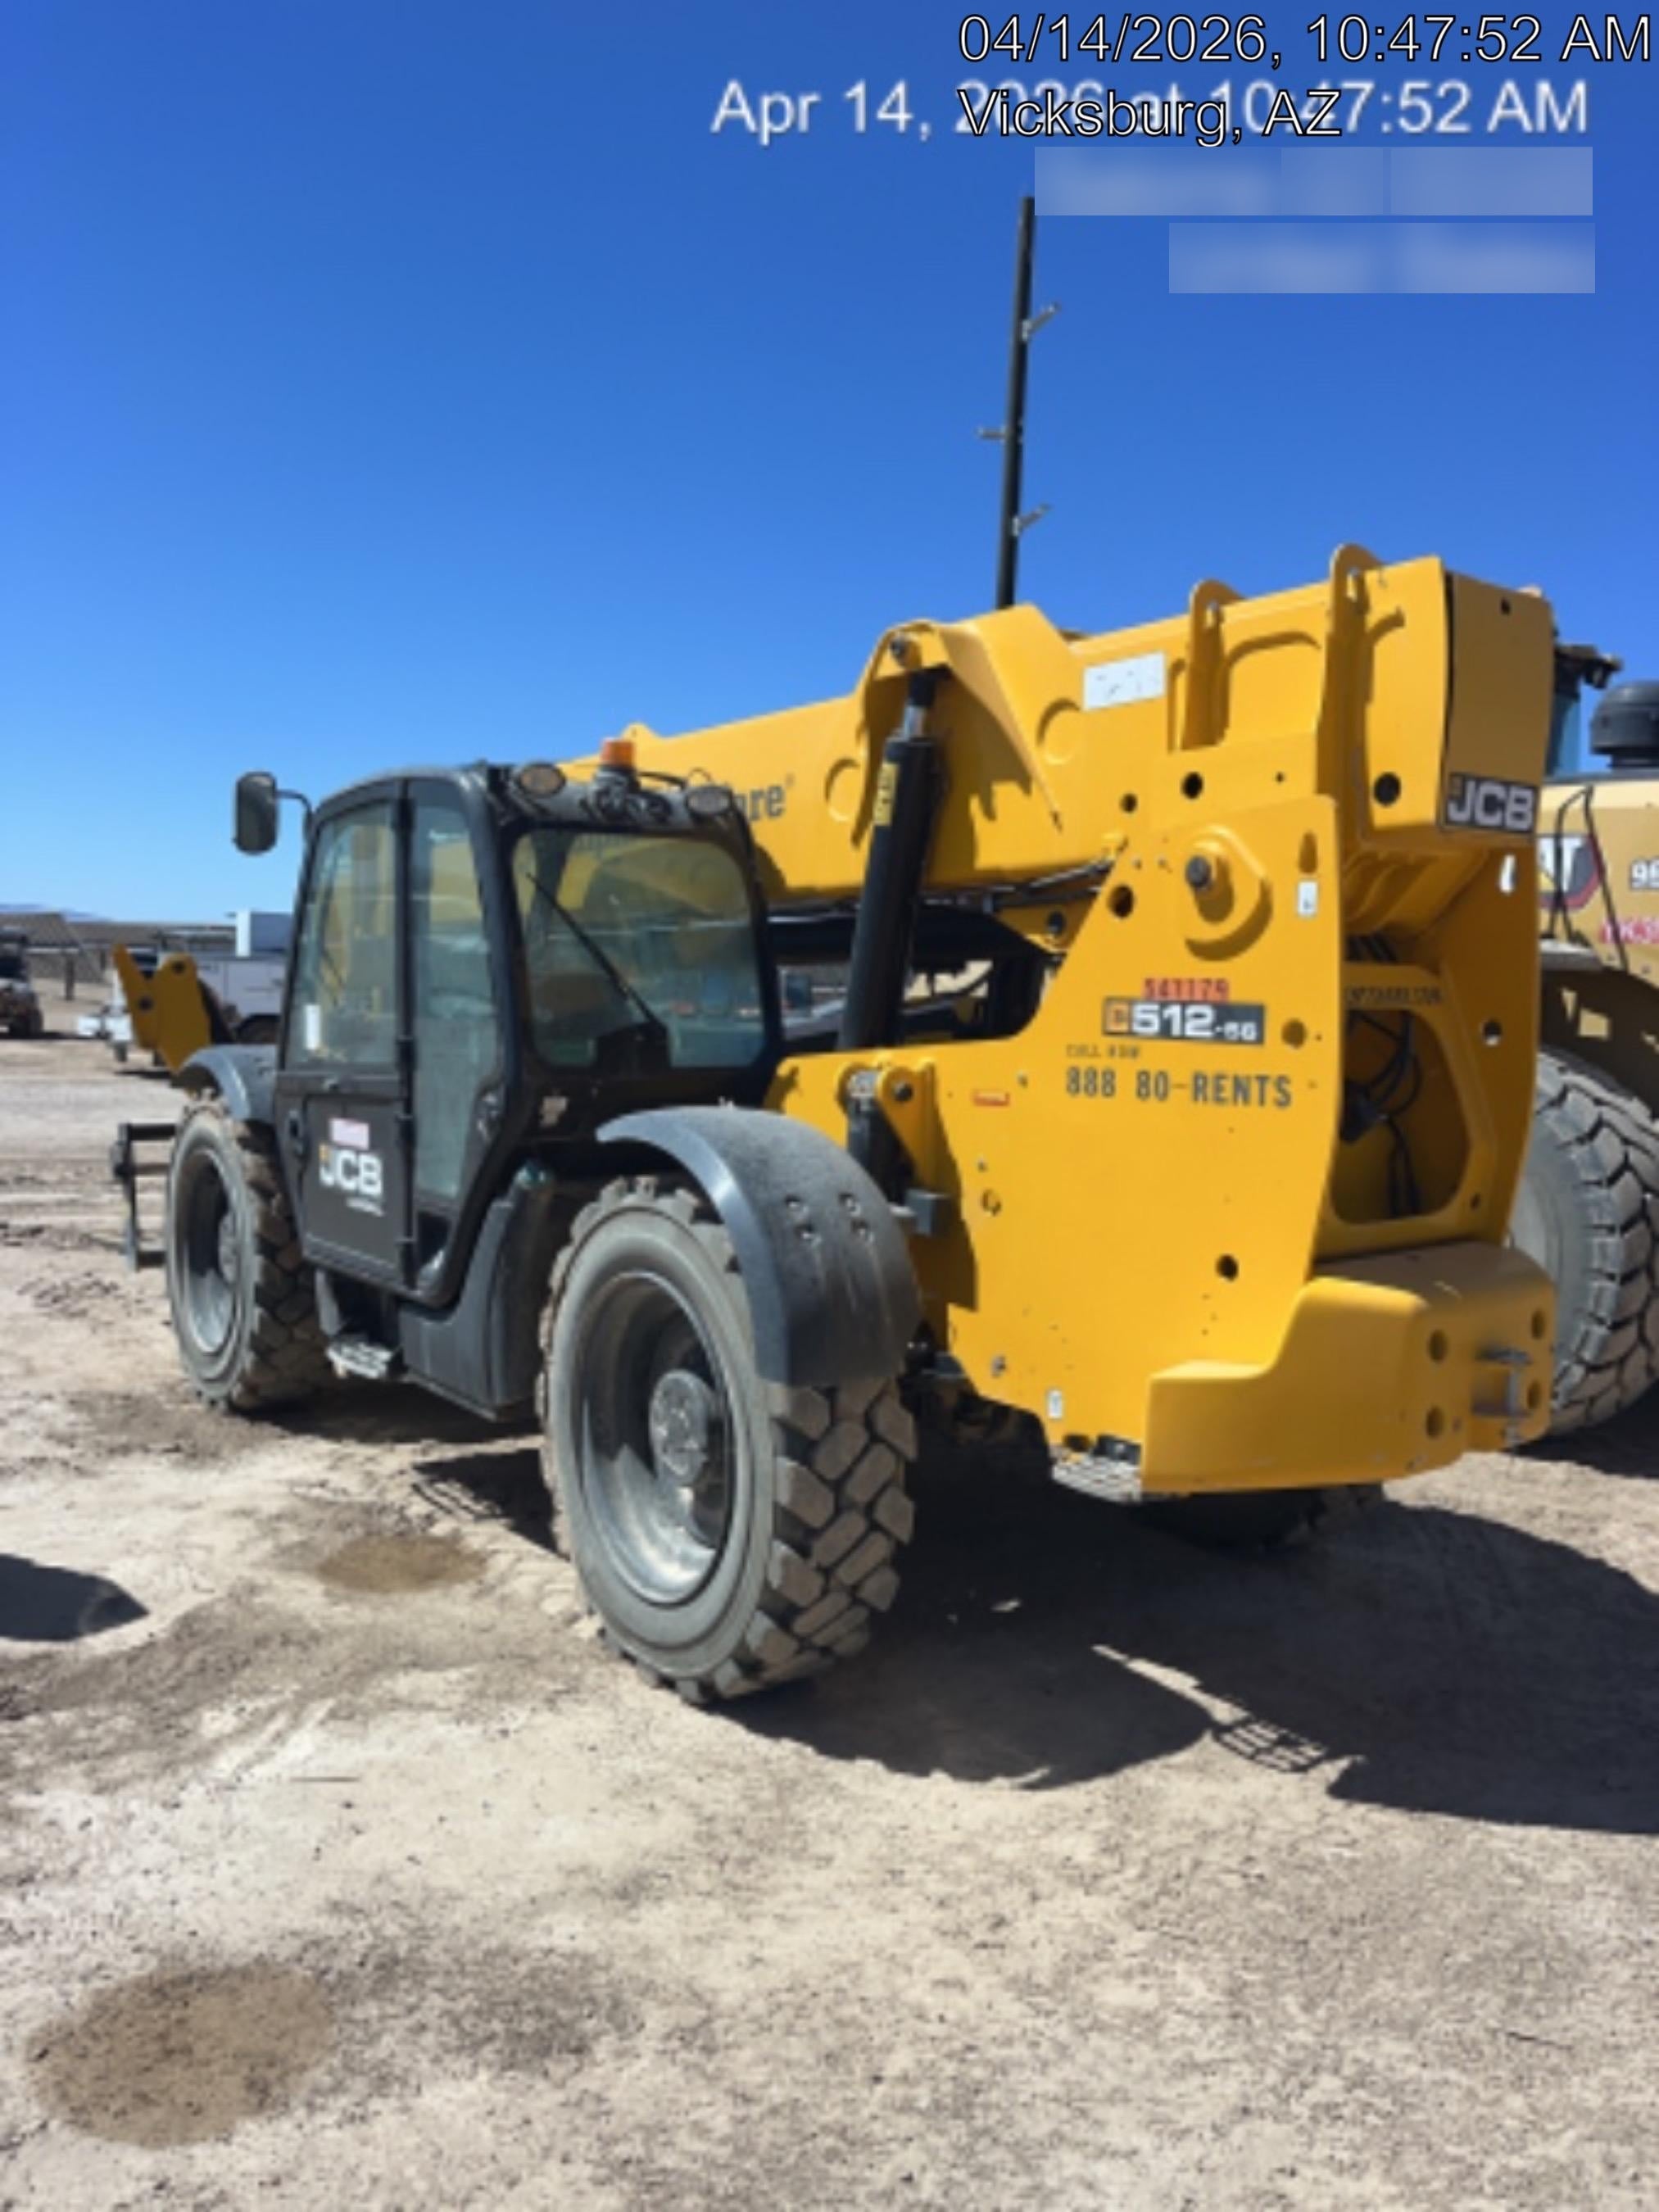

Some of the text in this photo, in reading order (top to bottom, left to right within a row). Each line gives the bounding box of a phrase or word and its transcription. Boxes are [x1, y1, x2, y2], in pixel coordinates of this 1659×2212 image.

[1447, 779, 1534, 831] JCB
[1066, 1066, 1292, 1108] 888 80-RENTS
[319, 1146, 383, 1196] JCB
